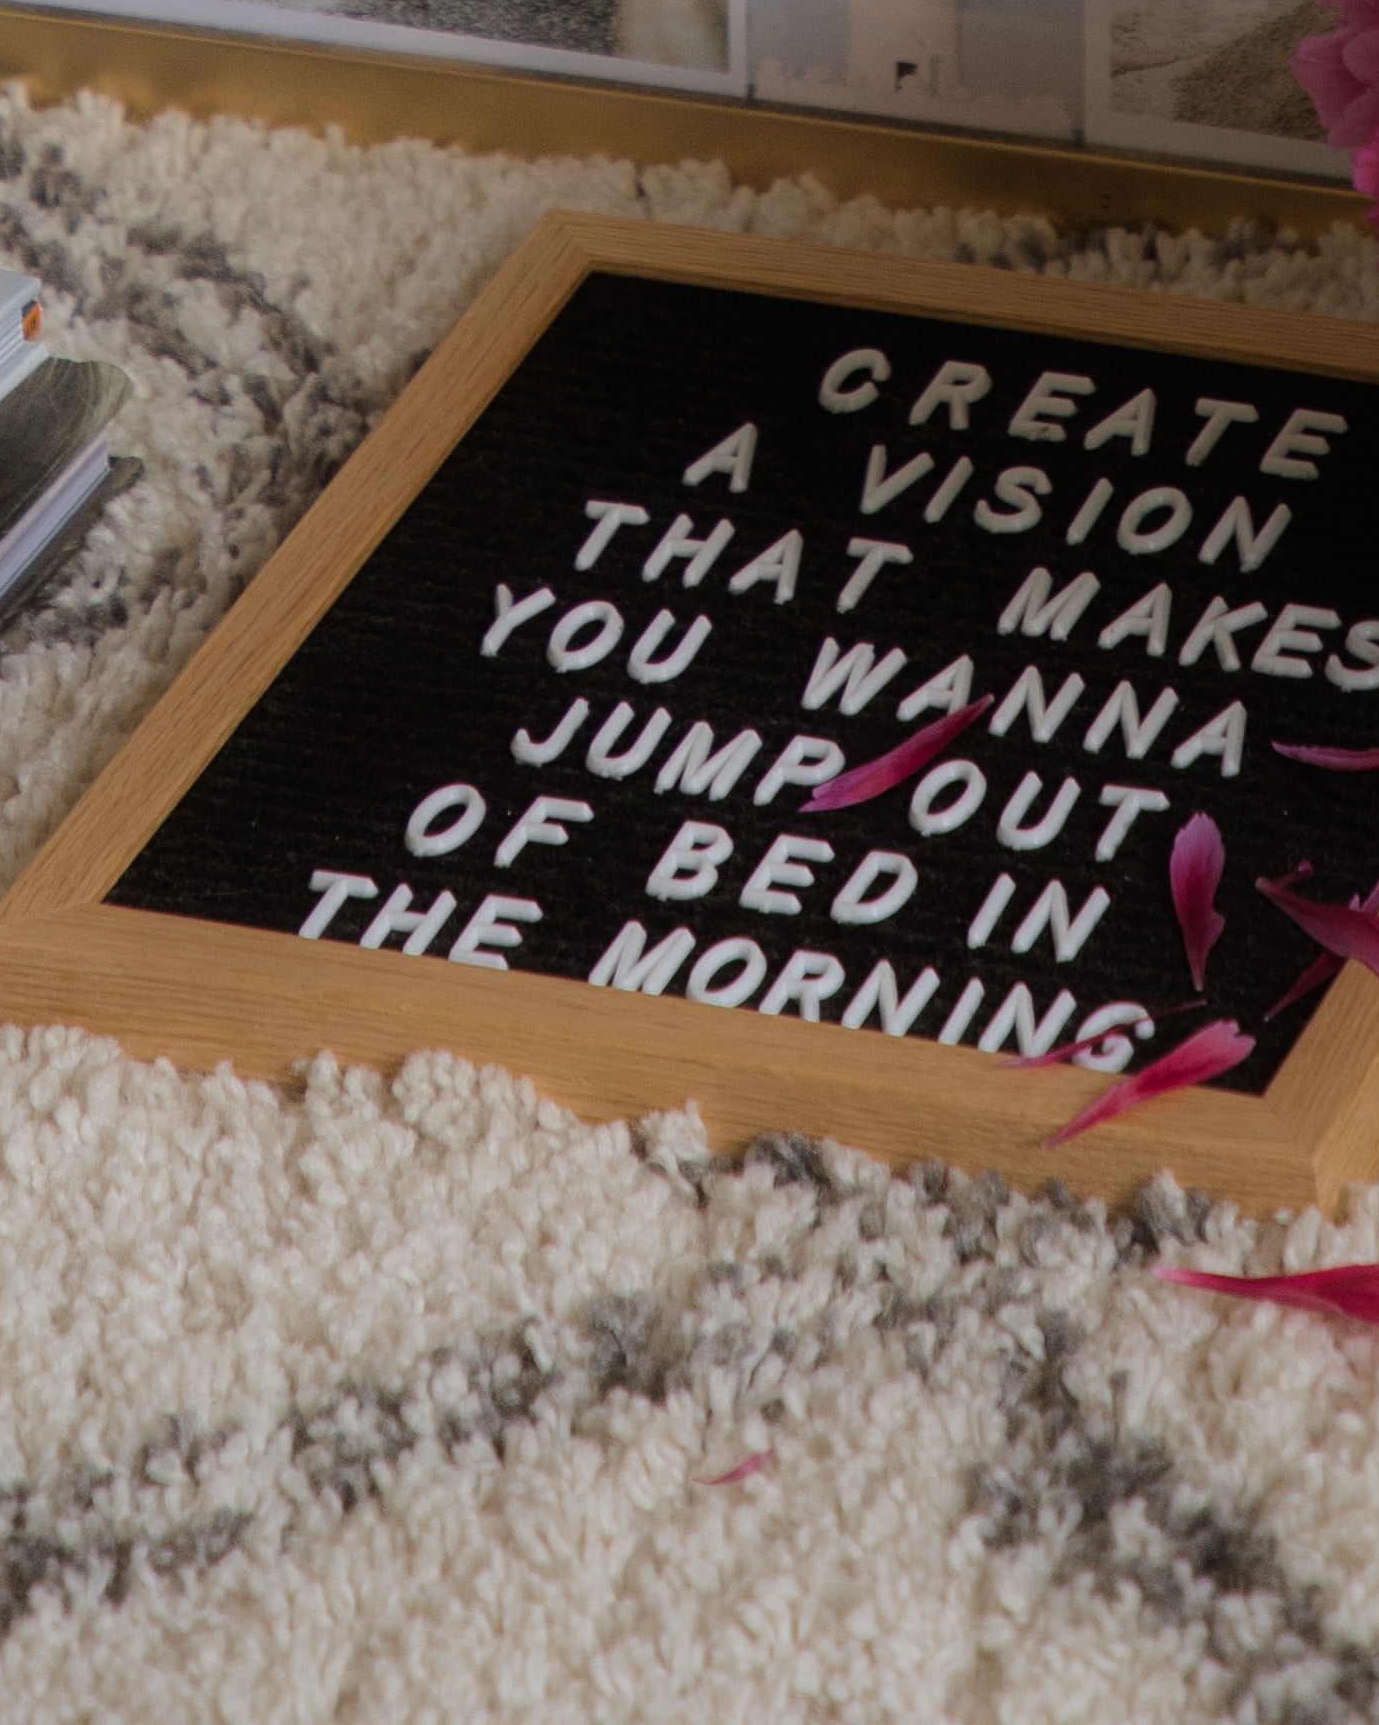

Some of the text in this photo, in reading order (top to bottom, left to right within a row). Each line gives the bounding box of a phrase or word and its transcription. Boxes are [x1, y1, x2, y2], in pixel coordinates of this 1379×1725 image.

[682, 422, 1293, 573] A VISION
[820, 348, 1349, 481] CREATE
[573, 499, 913, 615] THAT
[480, 582, 1249, 778] YOU WANNA
[510, 696, 1172, 862] JUMP OUT
[404, 783, 1111, 964] OF BED IN
[298, 869, 1157, 1073] THE MORNING
